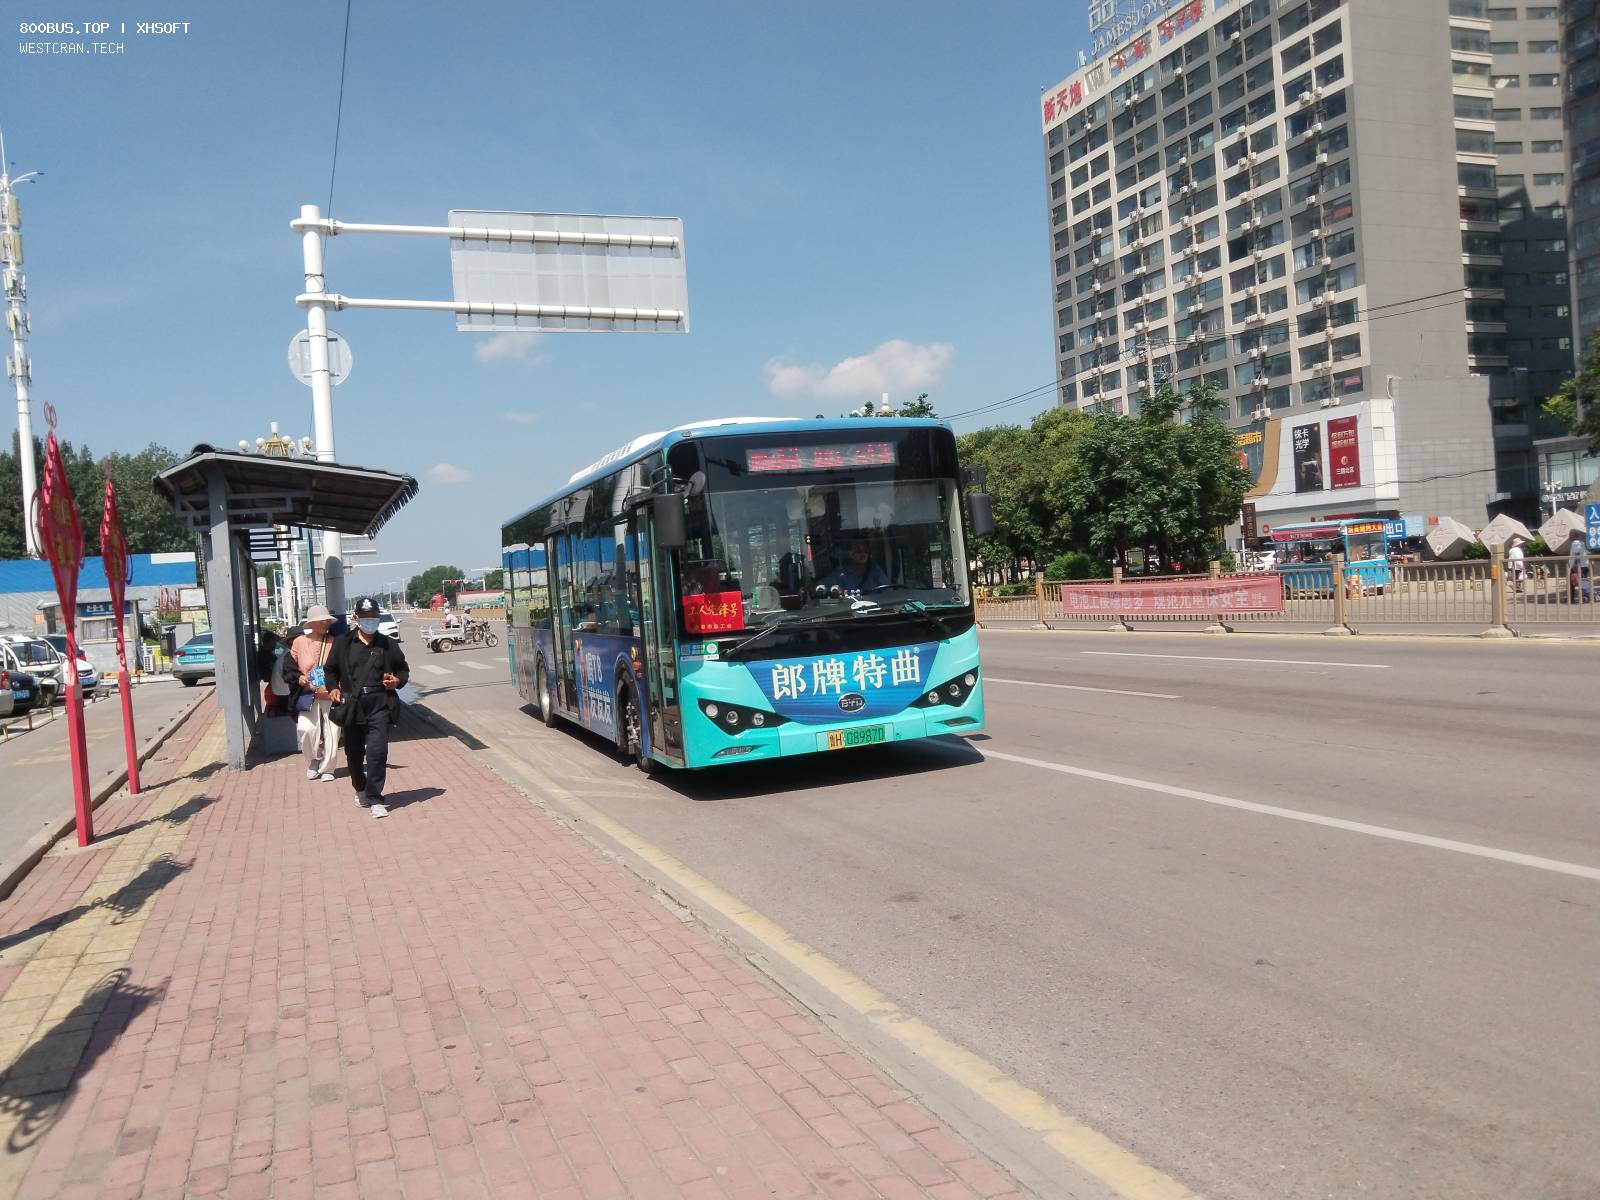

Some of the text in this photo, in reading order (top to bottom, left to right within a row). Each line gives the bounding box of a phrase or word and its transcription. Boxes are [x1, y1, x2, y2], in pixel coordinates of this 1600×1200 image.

[1043, 80, 1083, 125] 新天地
[1295, 438, 1310, 450] 光学
[1386, 522, 1403, 534] 出口
[687, 601, 738, 618] 工人先锋号
[771, 648, 921, 701] 郎牌特曲
[840, 697, 864, 708] BYD
